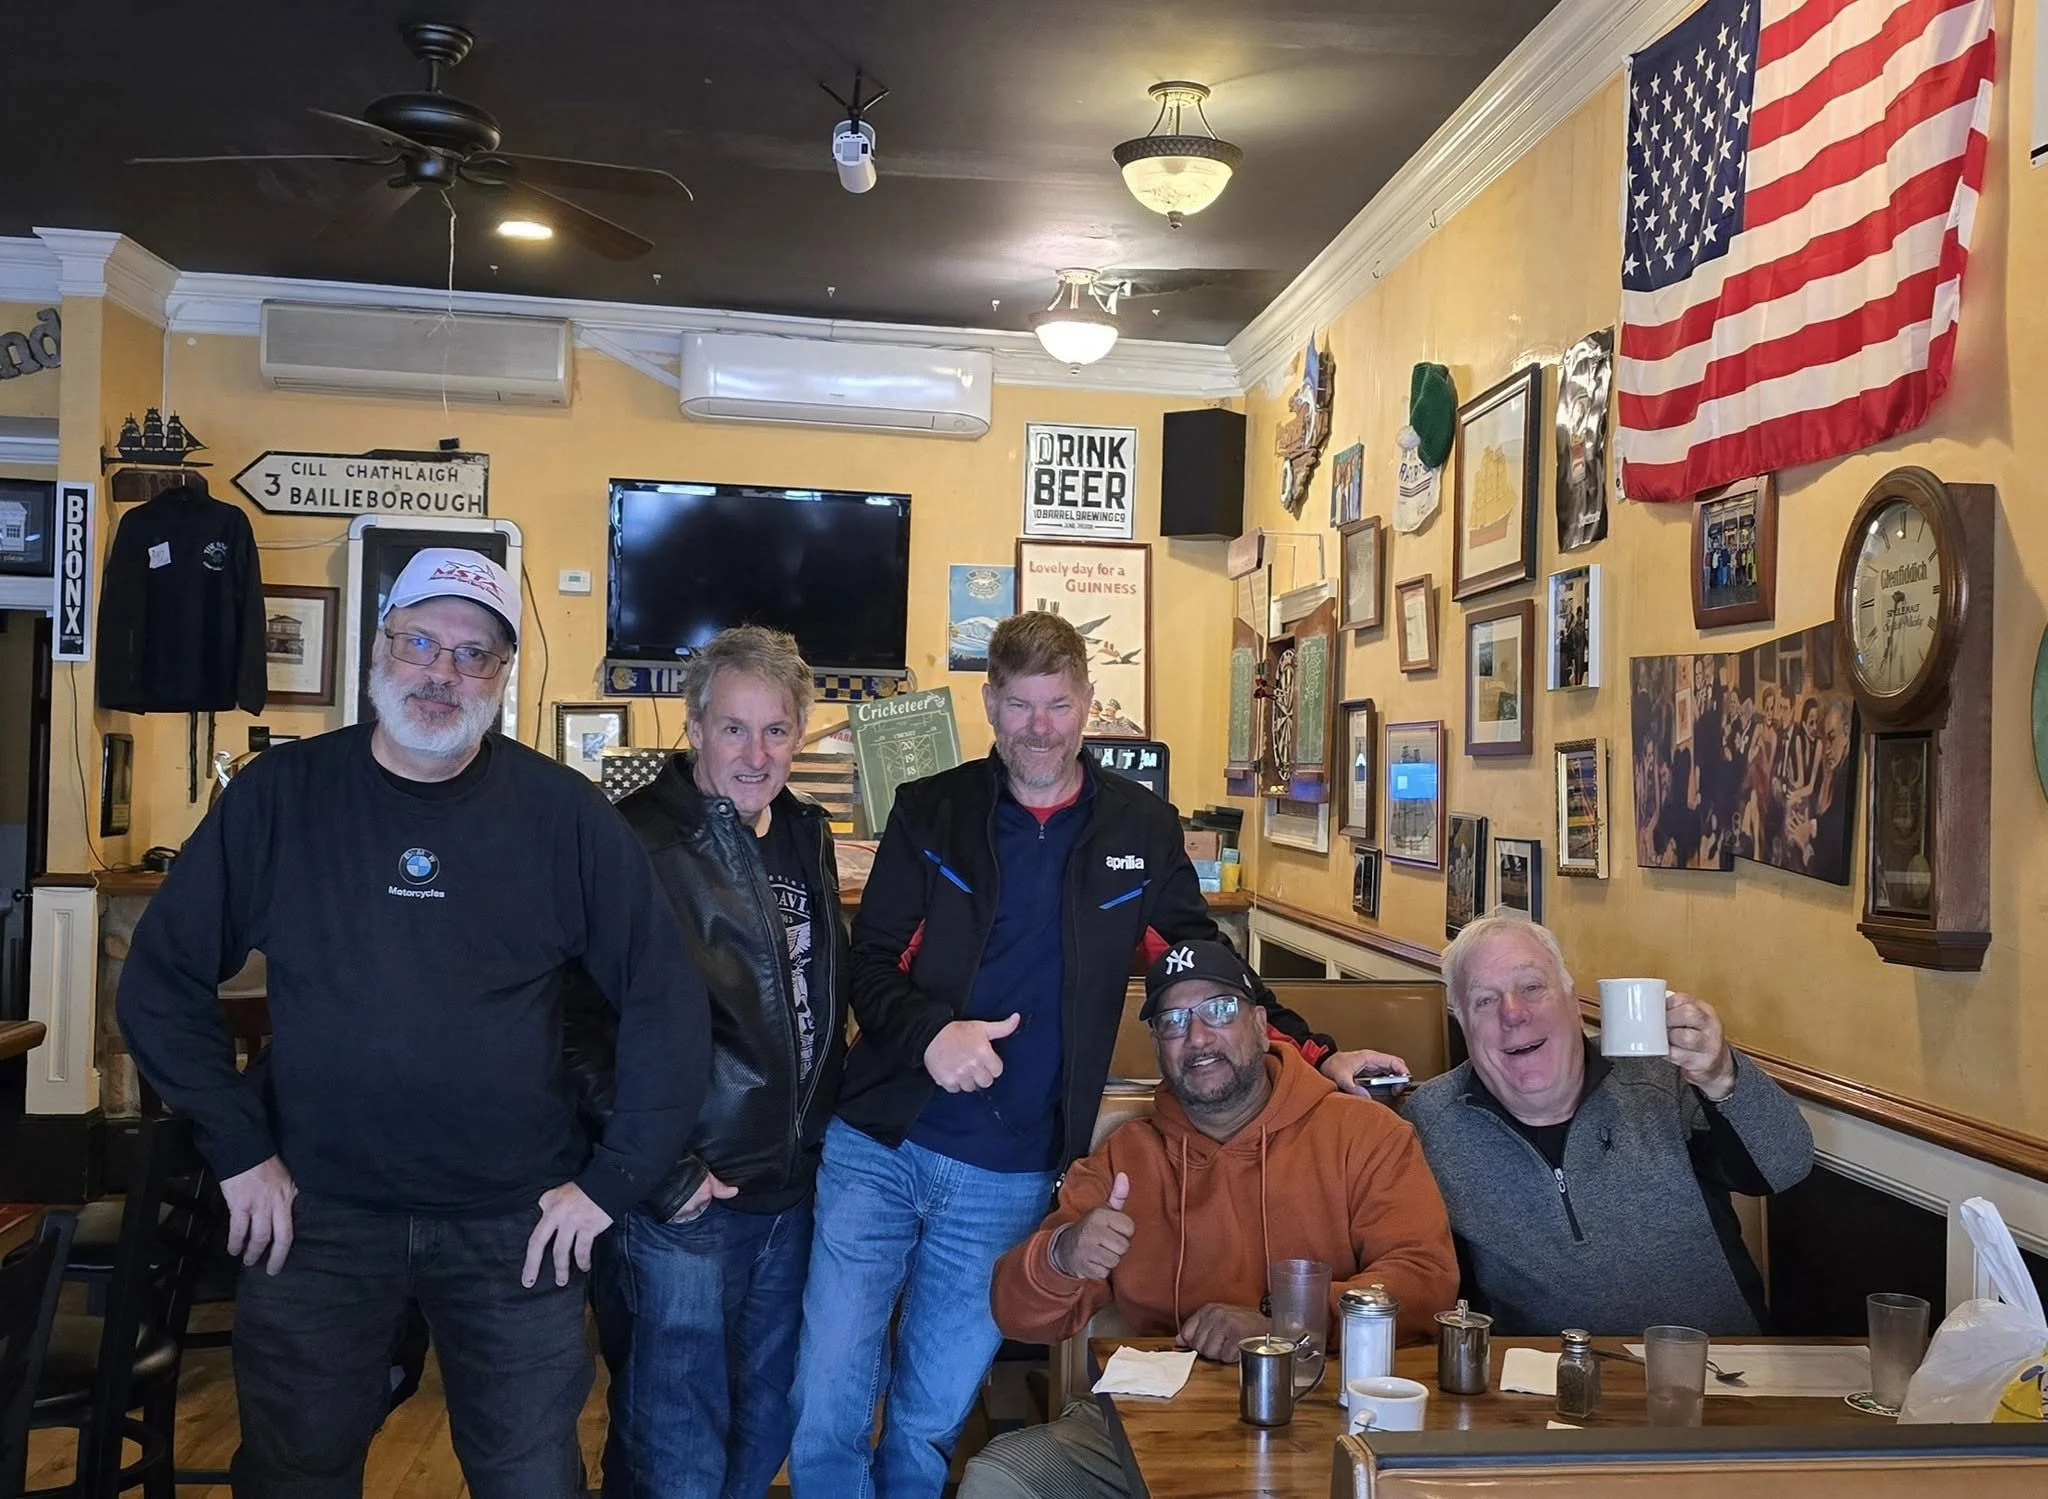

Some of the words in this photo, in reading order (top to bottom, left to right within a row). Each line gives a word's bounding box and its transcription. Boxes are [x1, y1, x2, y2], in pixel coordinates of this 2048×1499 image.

[1035, 432, 1127, 469] DRINK
[291, 462, 327, 476] CILL
[346, 464, 459, 482] CHATHLAIGH
[264, 473, 281, 496] 3
[1034, 468, 1126, 509] BEER
[290, 487, 482, 513] BAILIEBOROUGH
[65, 495, 85, 635] BRONX
[1029, 561, 1069, 577] Lovely
[1072, 562, 1094, 578] day
[1097, 563, 1115, 576] for
[1117, 567, 1126, 576] a
[1880, 561, 1928, 590] Glenfiddich
[1065, 578, 1137, 595] GUINNESS
[859, 699, 929, 721] Cricketeer
[1106, 855, 1145, 871] aprilia
[388, 886, 445, 899] Motorcycles
[1165, 946, 1195, 975] NY
